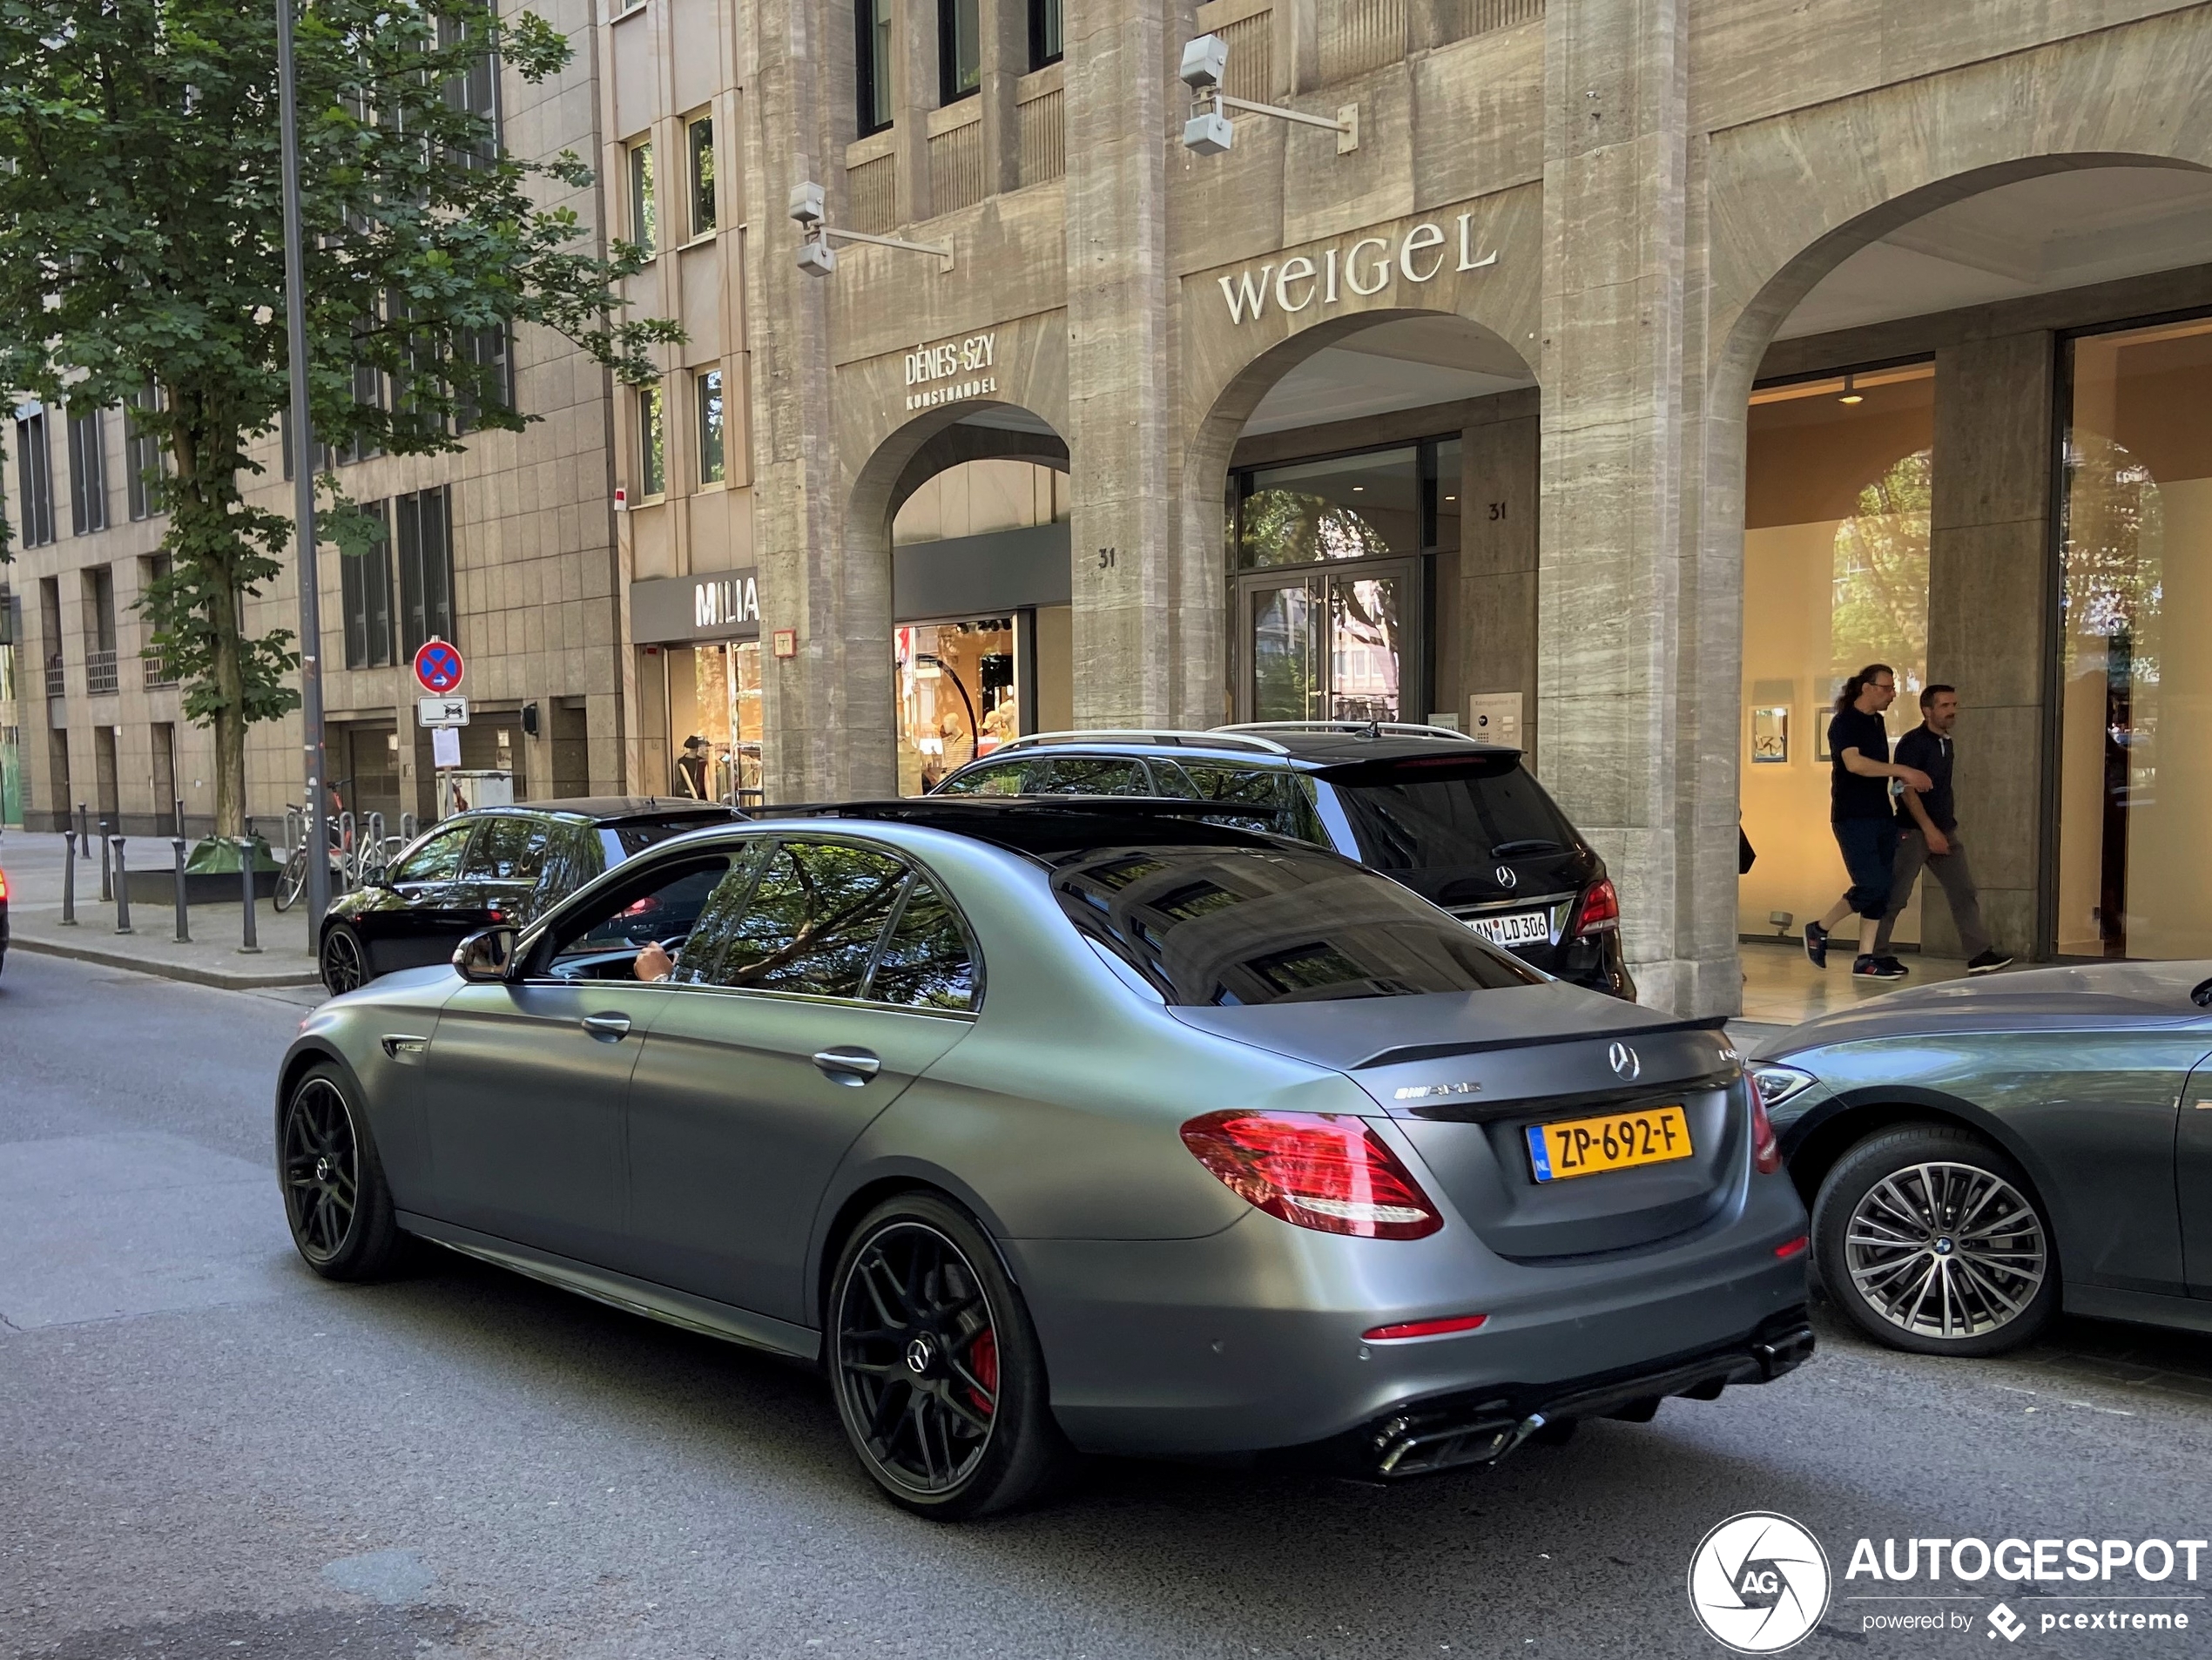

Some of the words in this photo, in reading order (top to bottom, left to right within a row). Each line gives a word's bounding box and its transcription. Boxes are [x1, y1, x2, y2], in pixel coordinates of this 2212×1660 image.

[905, 343, 958, 386] DÉNES
[963, 332, 995, 371] SZY
[906, 376, 998, 411] KUNSTHANDEL
[1488, 502, 1506, 521] 31
[1098, 547, 1115, 569] 31
[695, 577, 760, 628] MILIA
[1501, 919, 1521, 941] LD
[1521, 915, 1547, 938] 306
[1555, 1115, 1676, 1170] ZP-692-F
[1535, 1158, 1549, 1172] NL
